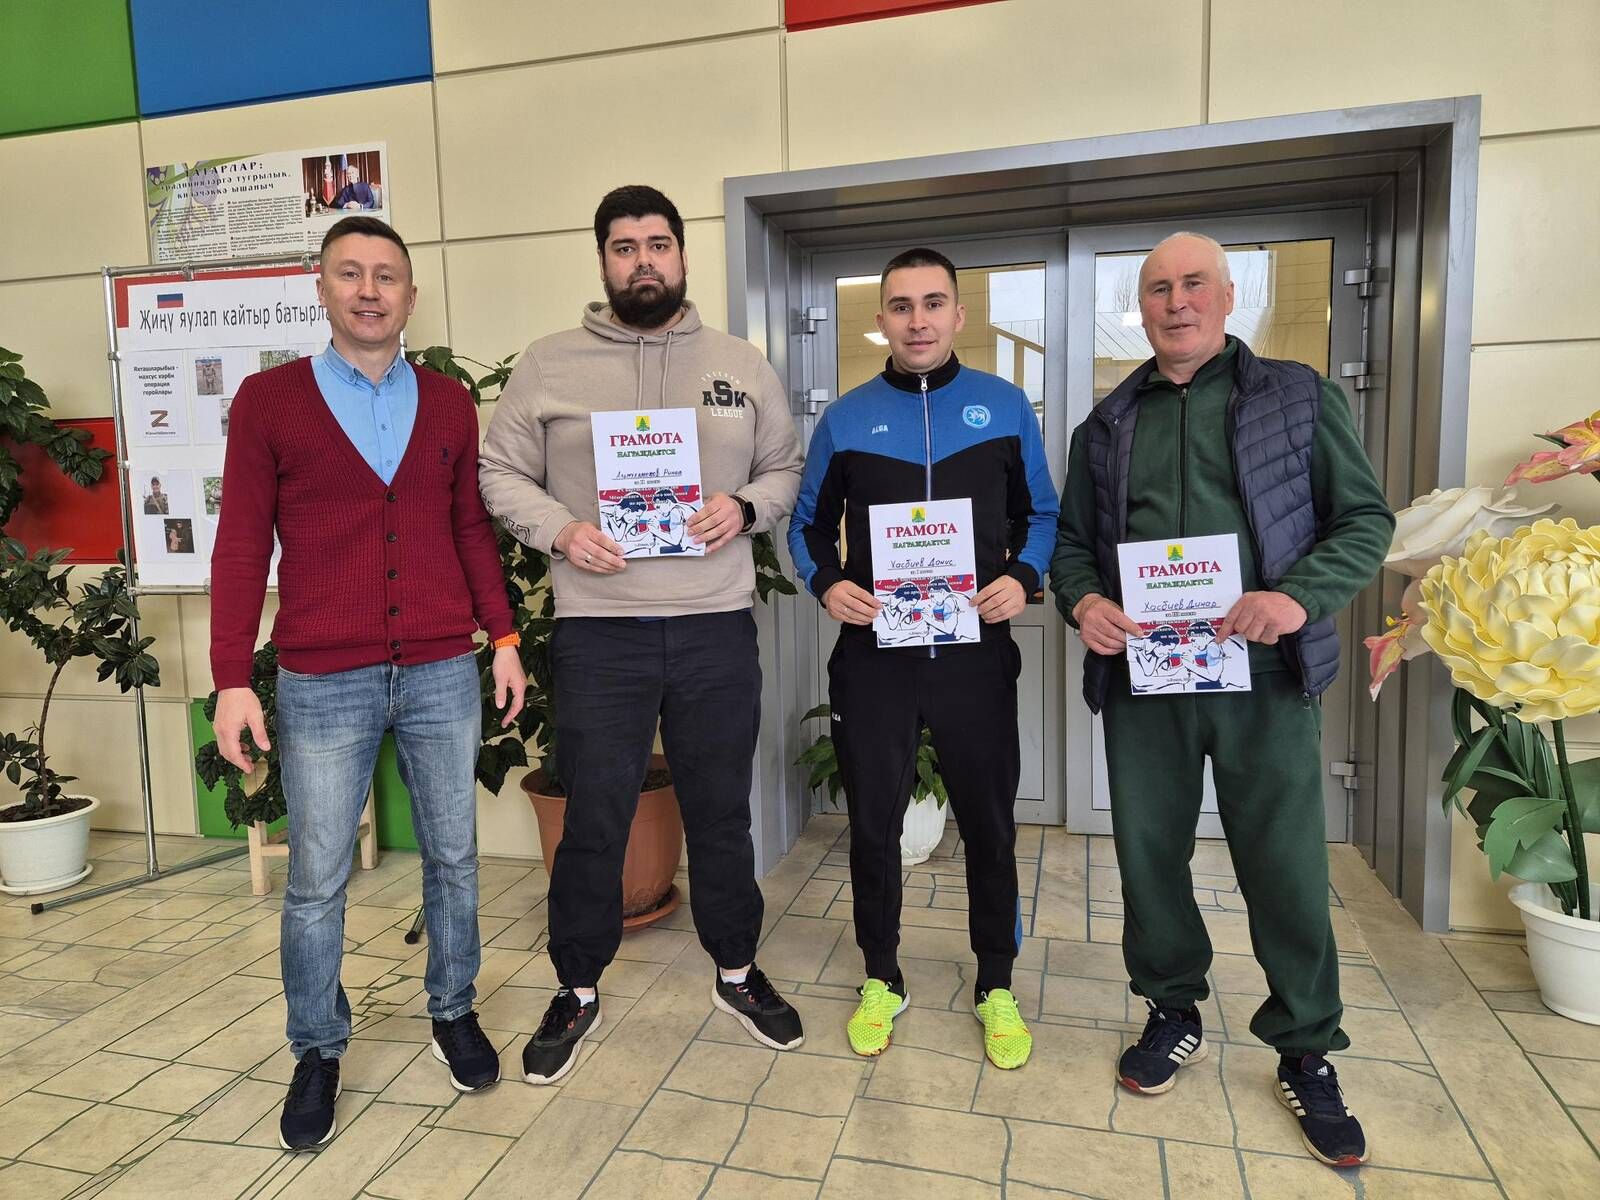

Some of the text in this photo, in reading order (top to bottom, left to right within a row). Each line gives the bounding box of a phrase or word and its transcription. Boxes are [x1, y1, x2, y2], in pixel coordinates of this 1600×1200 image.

[139, 309, 174, 334] Җиңү
[180, 309, 217, 333] яулап
[223, 303, 270, 330] кайтыр
[711, 408, 744, 419] LEAGUE
[609, 431, 684, 448] ГРАМОТА
[616, 448, 676, 459] НАГРАЖДАЕТСЯ
[886, 522, 958, 539] ГРАМОТА
[892, 538, 951, 550] НАГРАЖДАЕТСЯ
[1137, 560, 1222, 579] ГРАМОТА
[1145, 577, 1214, 590] НАГРАЖДАЕТСЯ
[1144, 598, 1184, 612] Хасбиев
